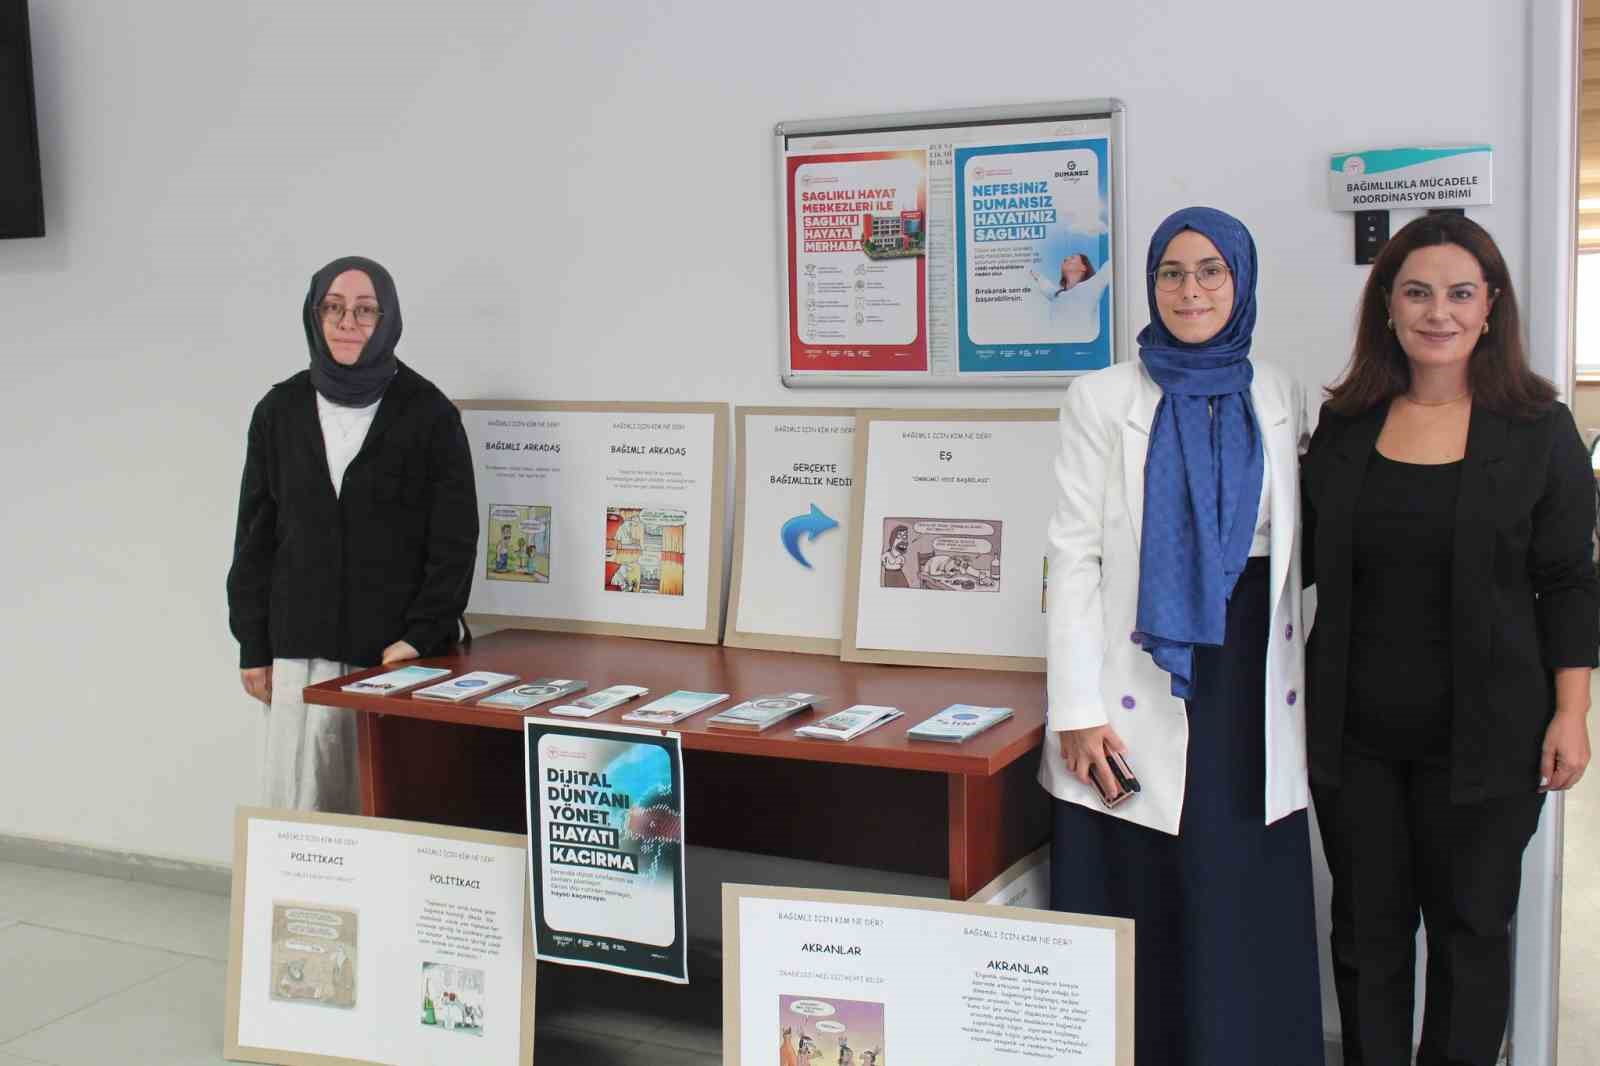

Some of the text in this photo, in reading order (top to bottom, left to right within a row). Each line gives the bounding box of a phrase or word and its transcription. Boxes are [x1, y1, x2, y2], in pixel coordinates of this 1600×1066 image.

[1347, 176, 1478, 192] BAĞIMLILIKLA MÜCADELE
[859, 188, 896, 199] HAYAT
[1353, 188, 1471, 204] KOORDİNASYON BİRİMİ
[973, 196, 1053, 211] DUMANSIZ
[975, 210, 1054, 226] HAYATINIZ
[805, 229, 851, 240] HAYATA
[805, 241, 862, 252] MERHABA
[486, 440, 561, 454] BAĞIMLI ARKADAŞ
[610, 444, 646, 454] BAĞIMLI
[939, 450, 953, 462] EŞ
[793, 463, 837, 473] GERÇEKTE
[770, 475, 823, 486] BAĞIMLILIK
[547, 784, 630, 809] DÜNYANI
[551, 825, 614, 846] HAYATI
[801, 943, 862, 956] AKRANLAR
[987, 960, 1049, 975] AKRANLAR
